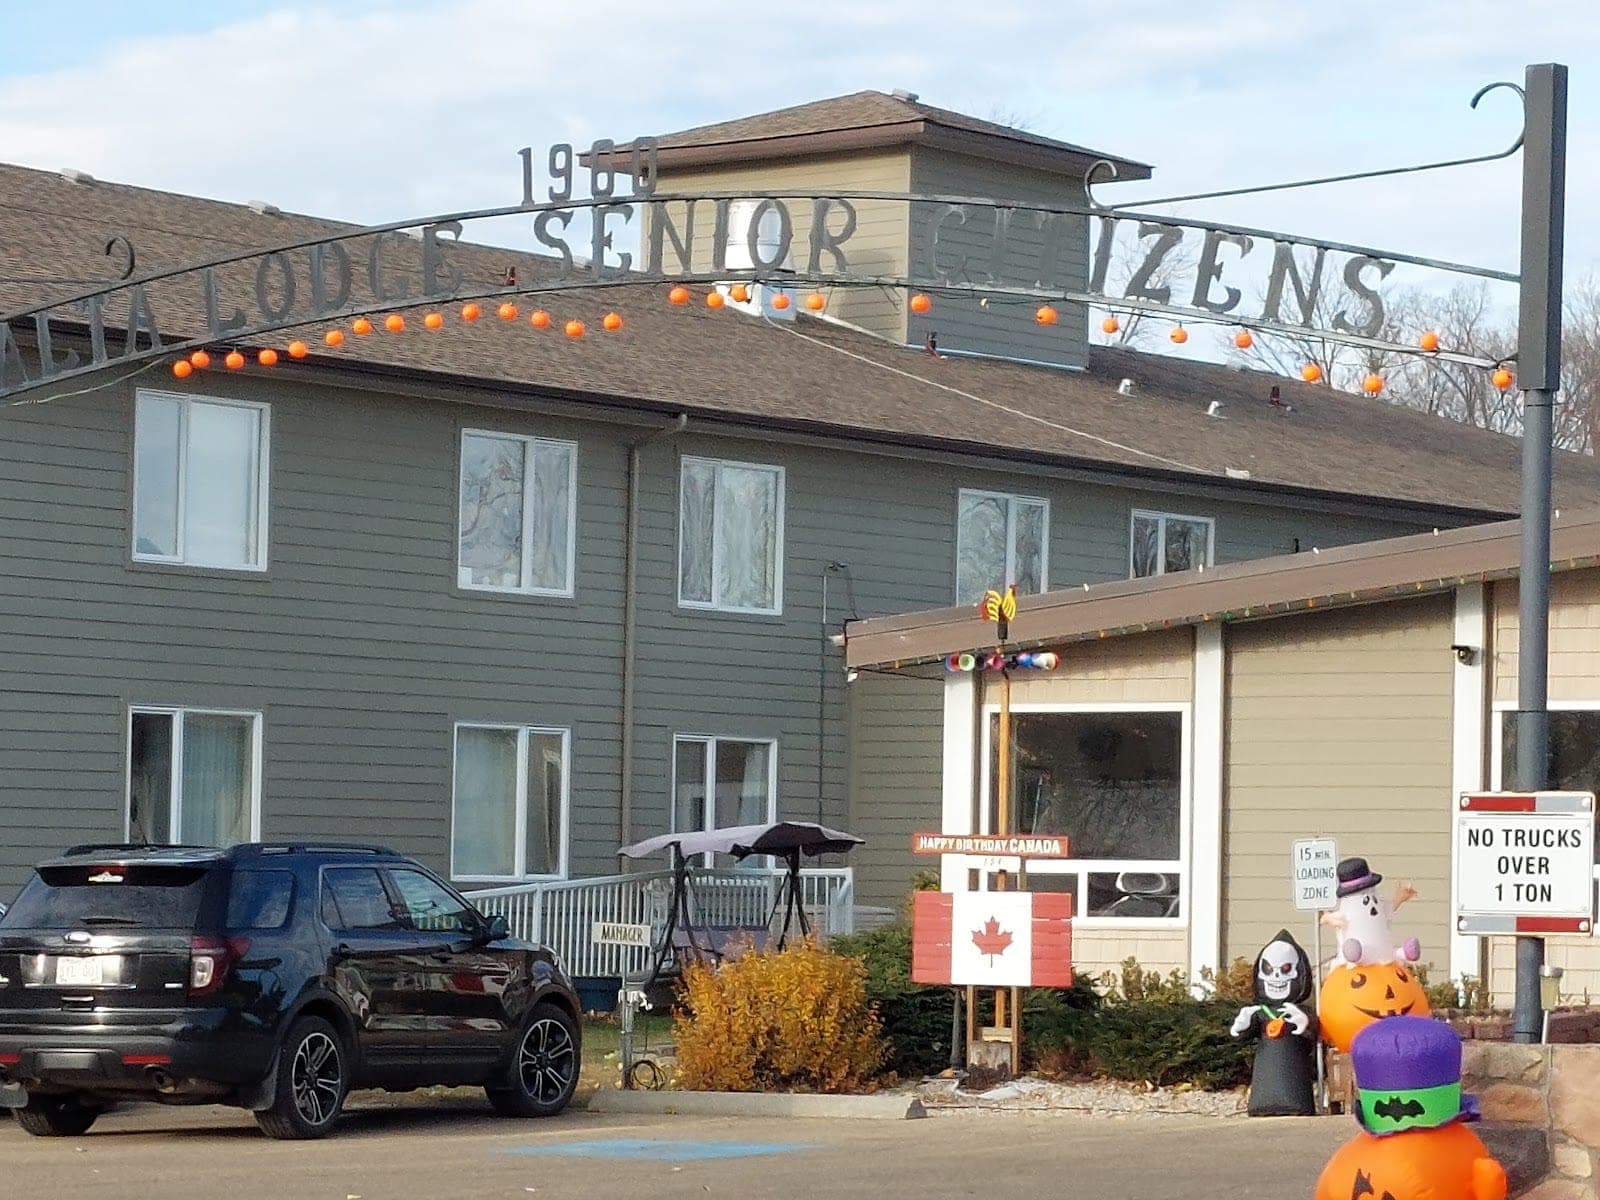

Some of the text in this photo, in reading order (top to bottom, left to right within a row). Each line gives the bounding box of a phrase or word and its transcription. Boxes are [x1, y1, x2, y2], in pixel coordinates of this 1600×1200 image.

[204, 220, 463, 337] LODGE
[533, 199, 857, 277] SENIOR
[927, 202, 1396, 338] CITIZENS
[919, 835, 1061, 854] HAPPY BIRTHDAY CANADA
[1467, 828, 1582, 848] NO TRUCKS
[1300, 847, 1312, 861] 15
[1296, 866, 1335, 880] LOADING
[1497, 856, 1550, 875] OVER
[1302, 886, 1329, 899] ZONE
[1495, 884, 1552, 902] 1 TON
[601, 925, 643, 942] MANAGER
